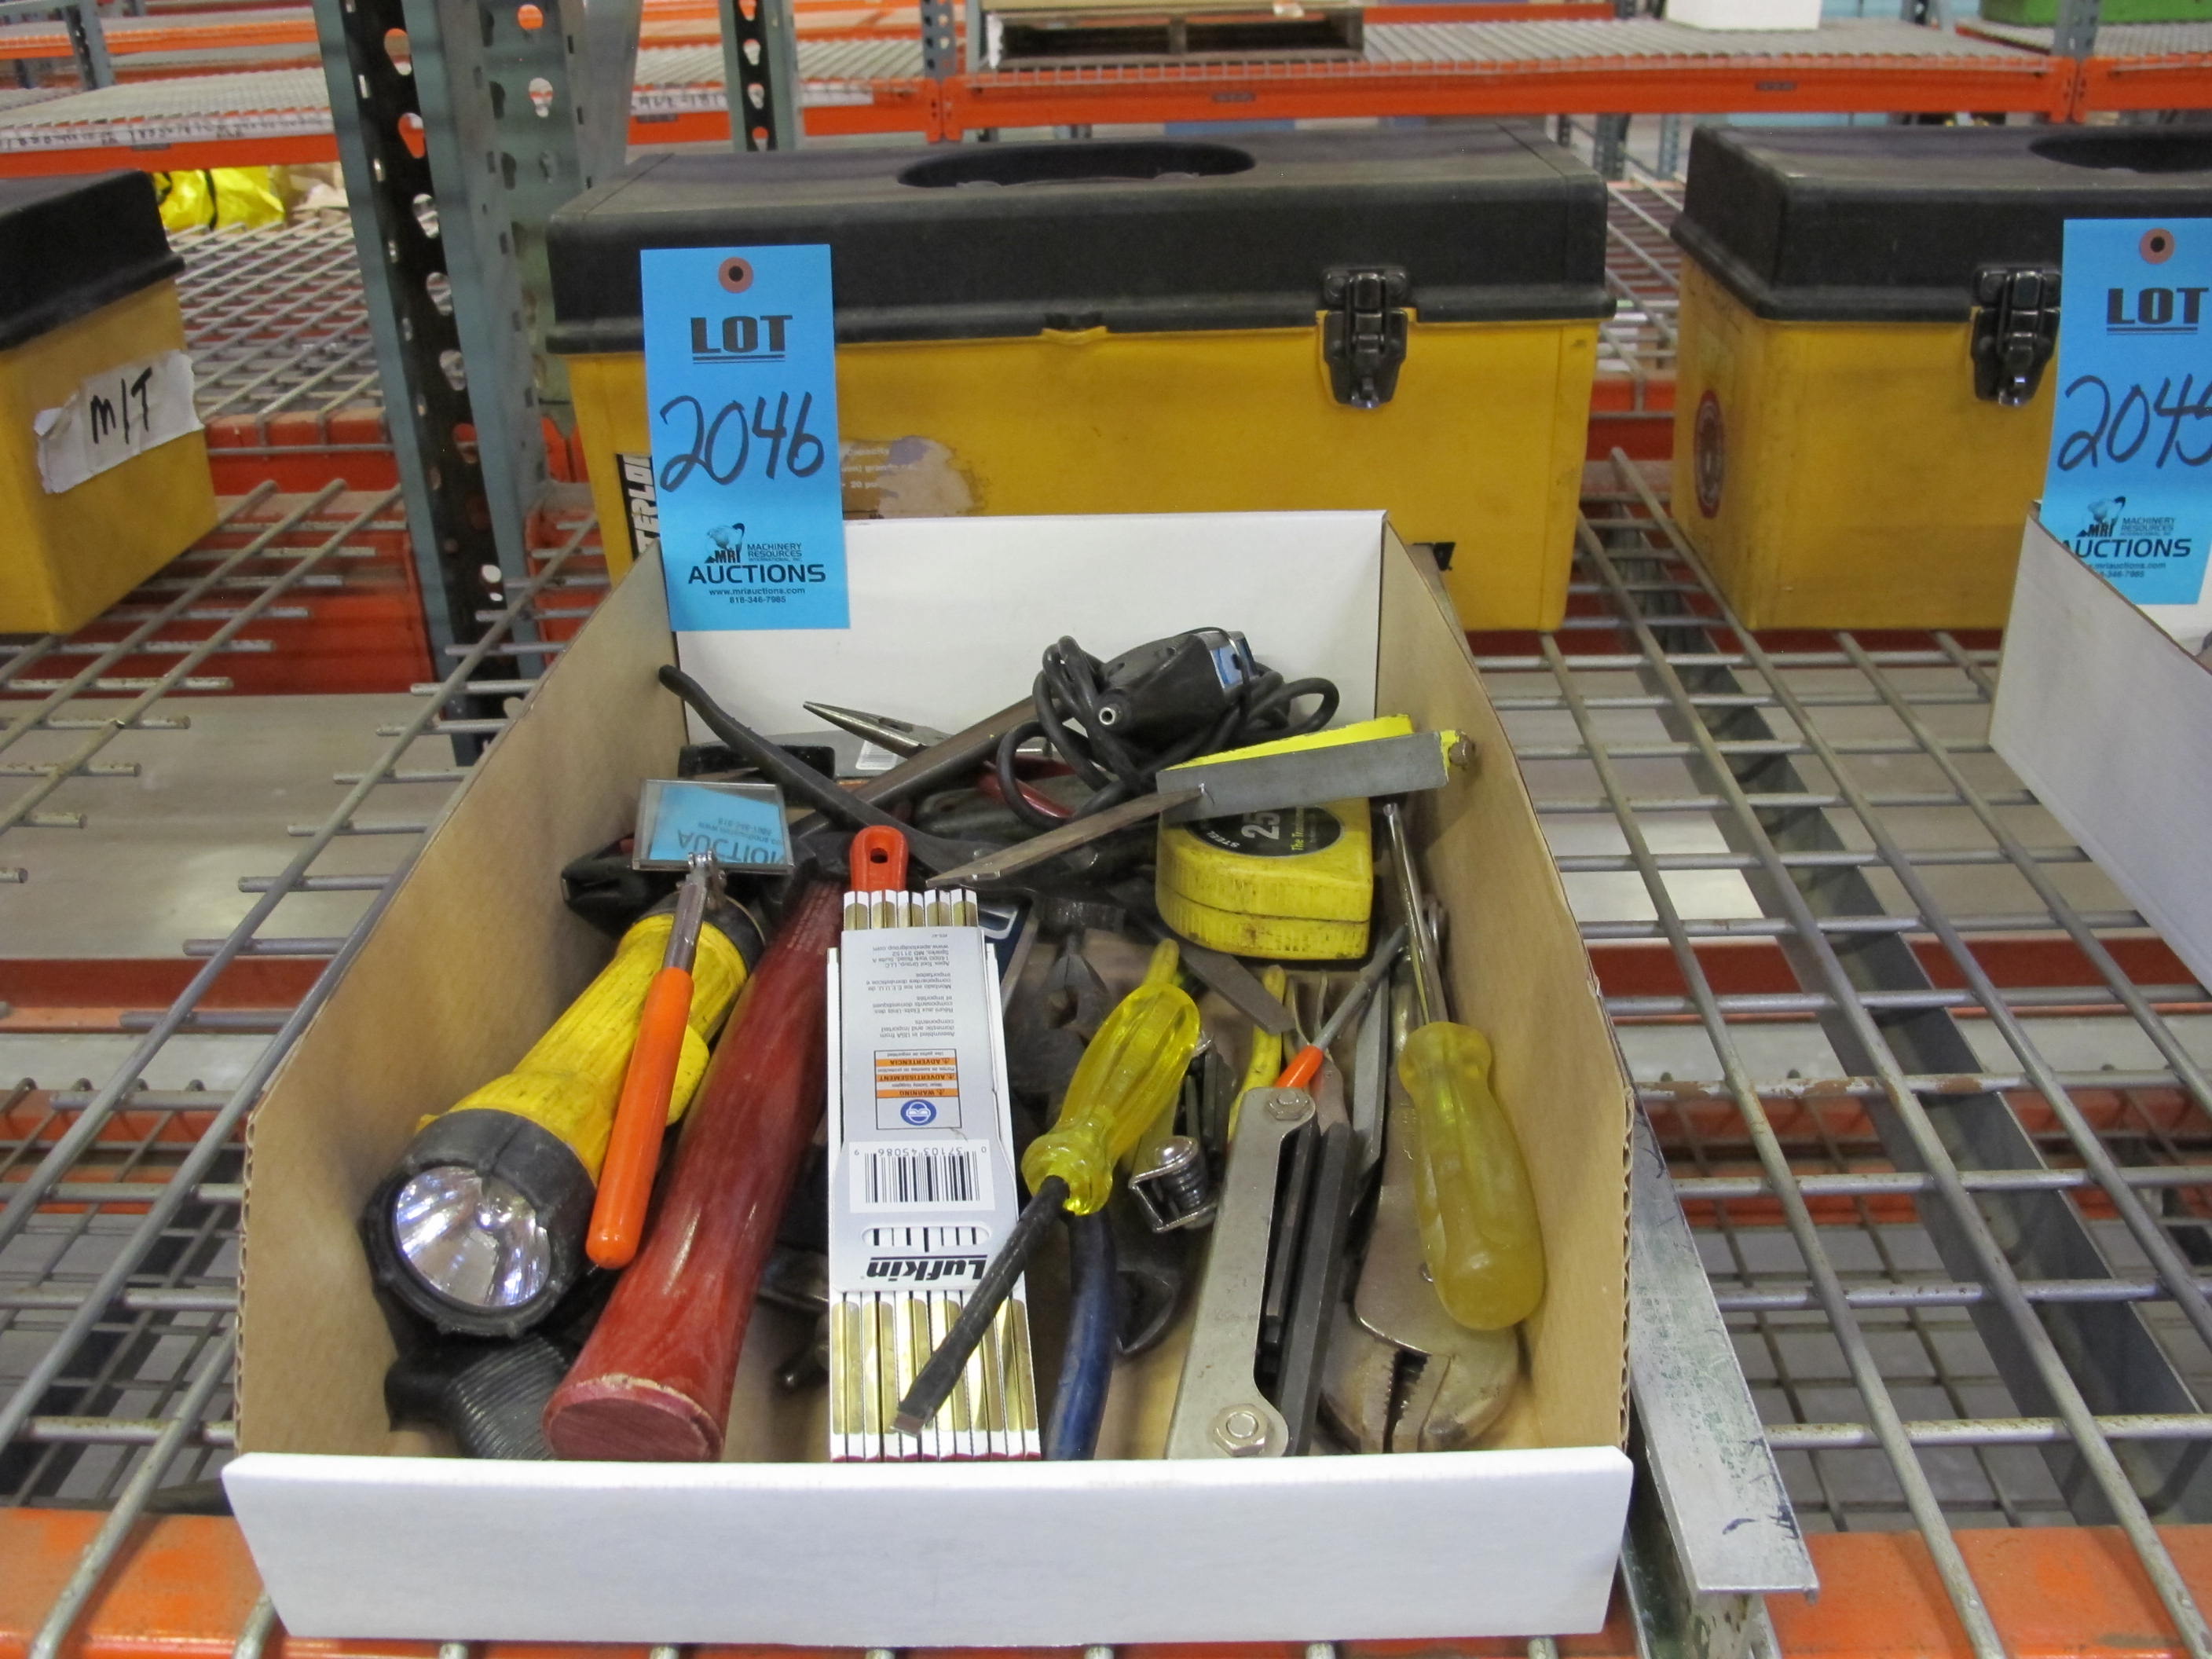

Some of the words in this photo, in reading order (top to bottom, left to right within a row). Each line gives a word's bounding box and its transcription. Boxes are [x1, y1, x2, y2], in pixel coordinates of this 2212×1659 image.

[2106, 287, 2209, 325] LOT
[691, 315, 793, 353] LOT
[660, 391, 824, 493] 2046
[2088, 522, 2115, 537] MRI
[714, 548, 742, 563] MRI
[688, 564, 826, 584] AUCTIONS
[1207, 830, 1240, 848] STEEL
[1291, 838, 1304, 851] The
[878, 1148, 917, 1157] 45086
[923, 1147, 962, 1156] 37103
[866, 1260, 987, 1281] Lufkin
